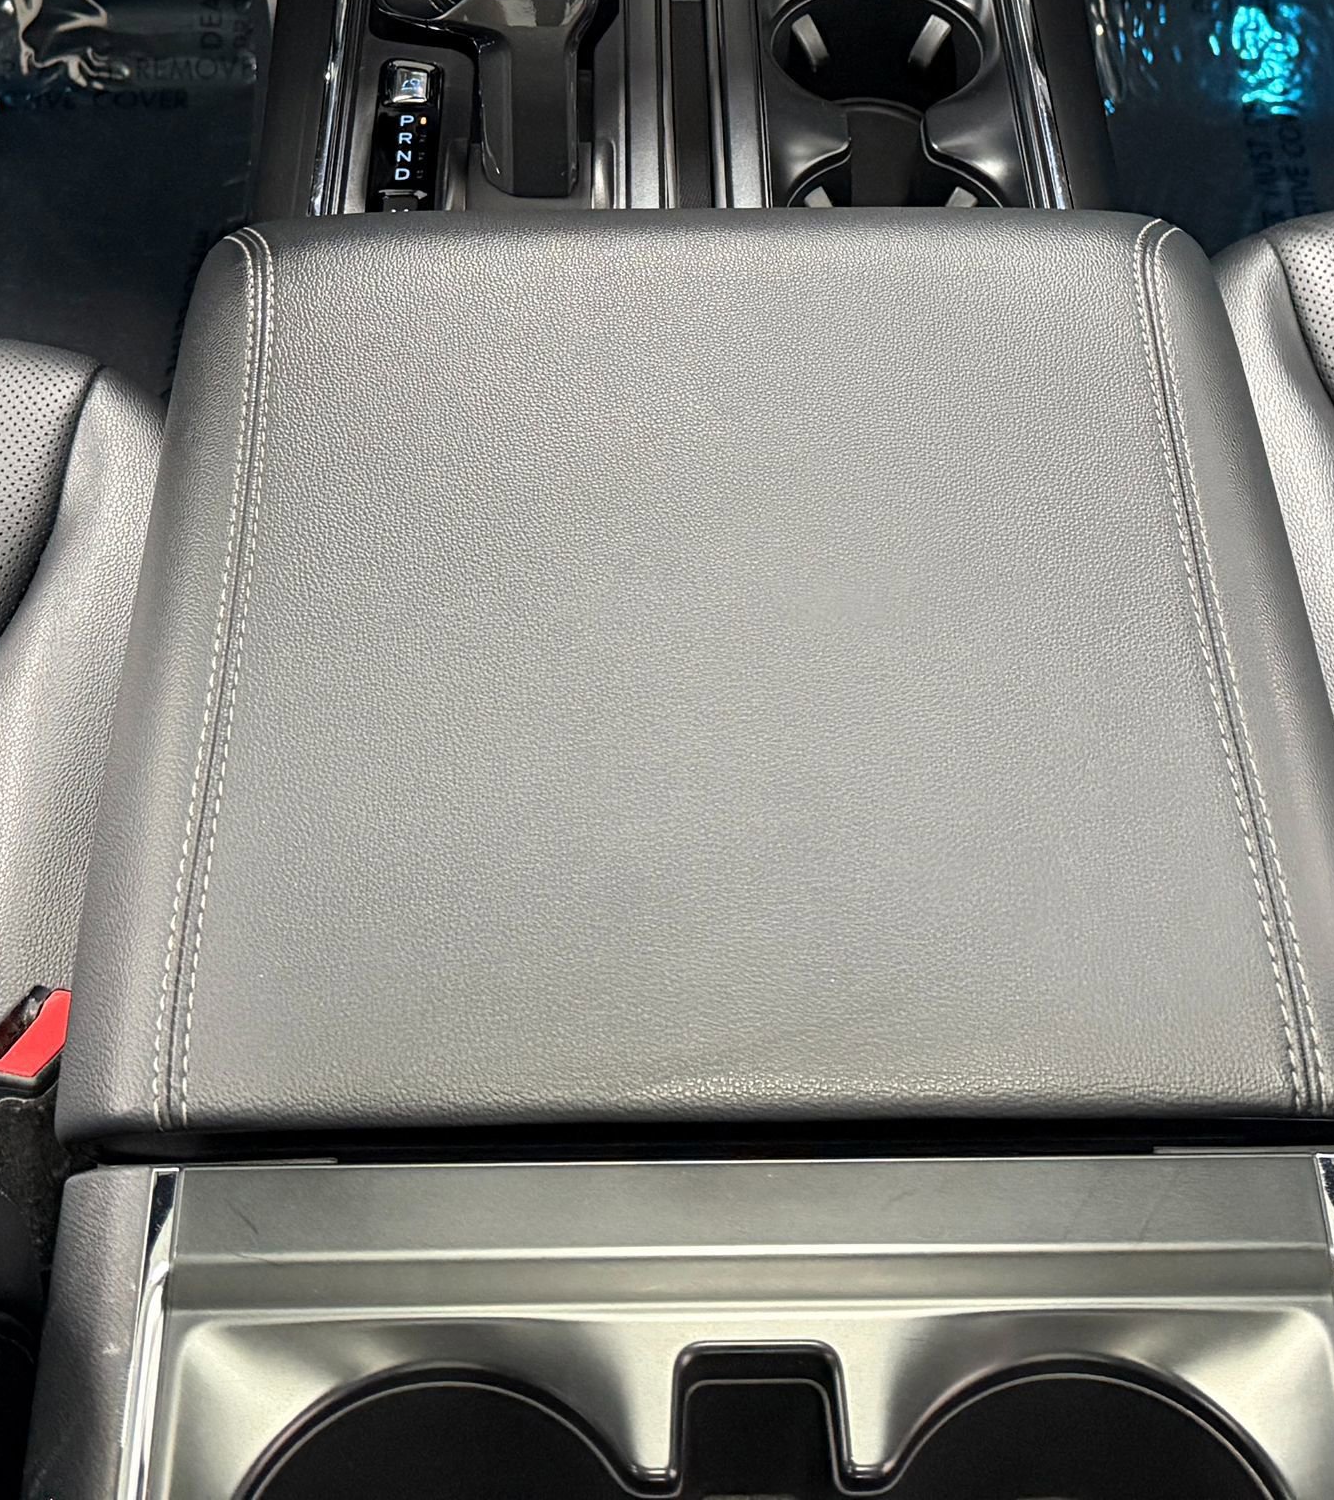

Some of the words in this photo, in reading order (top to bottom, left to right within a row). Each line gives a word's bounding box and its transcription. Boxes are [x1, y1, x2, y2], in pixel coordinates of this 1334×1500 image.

[400, 115, 414, 126] P
[398, 133, 413, 144] R
[396, 150, 411, 162] N
[394, 168, 410, 181] D
